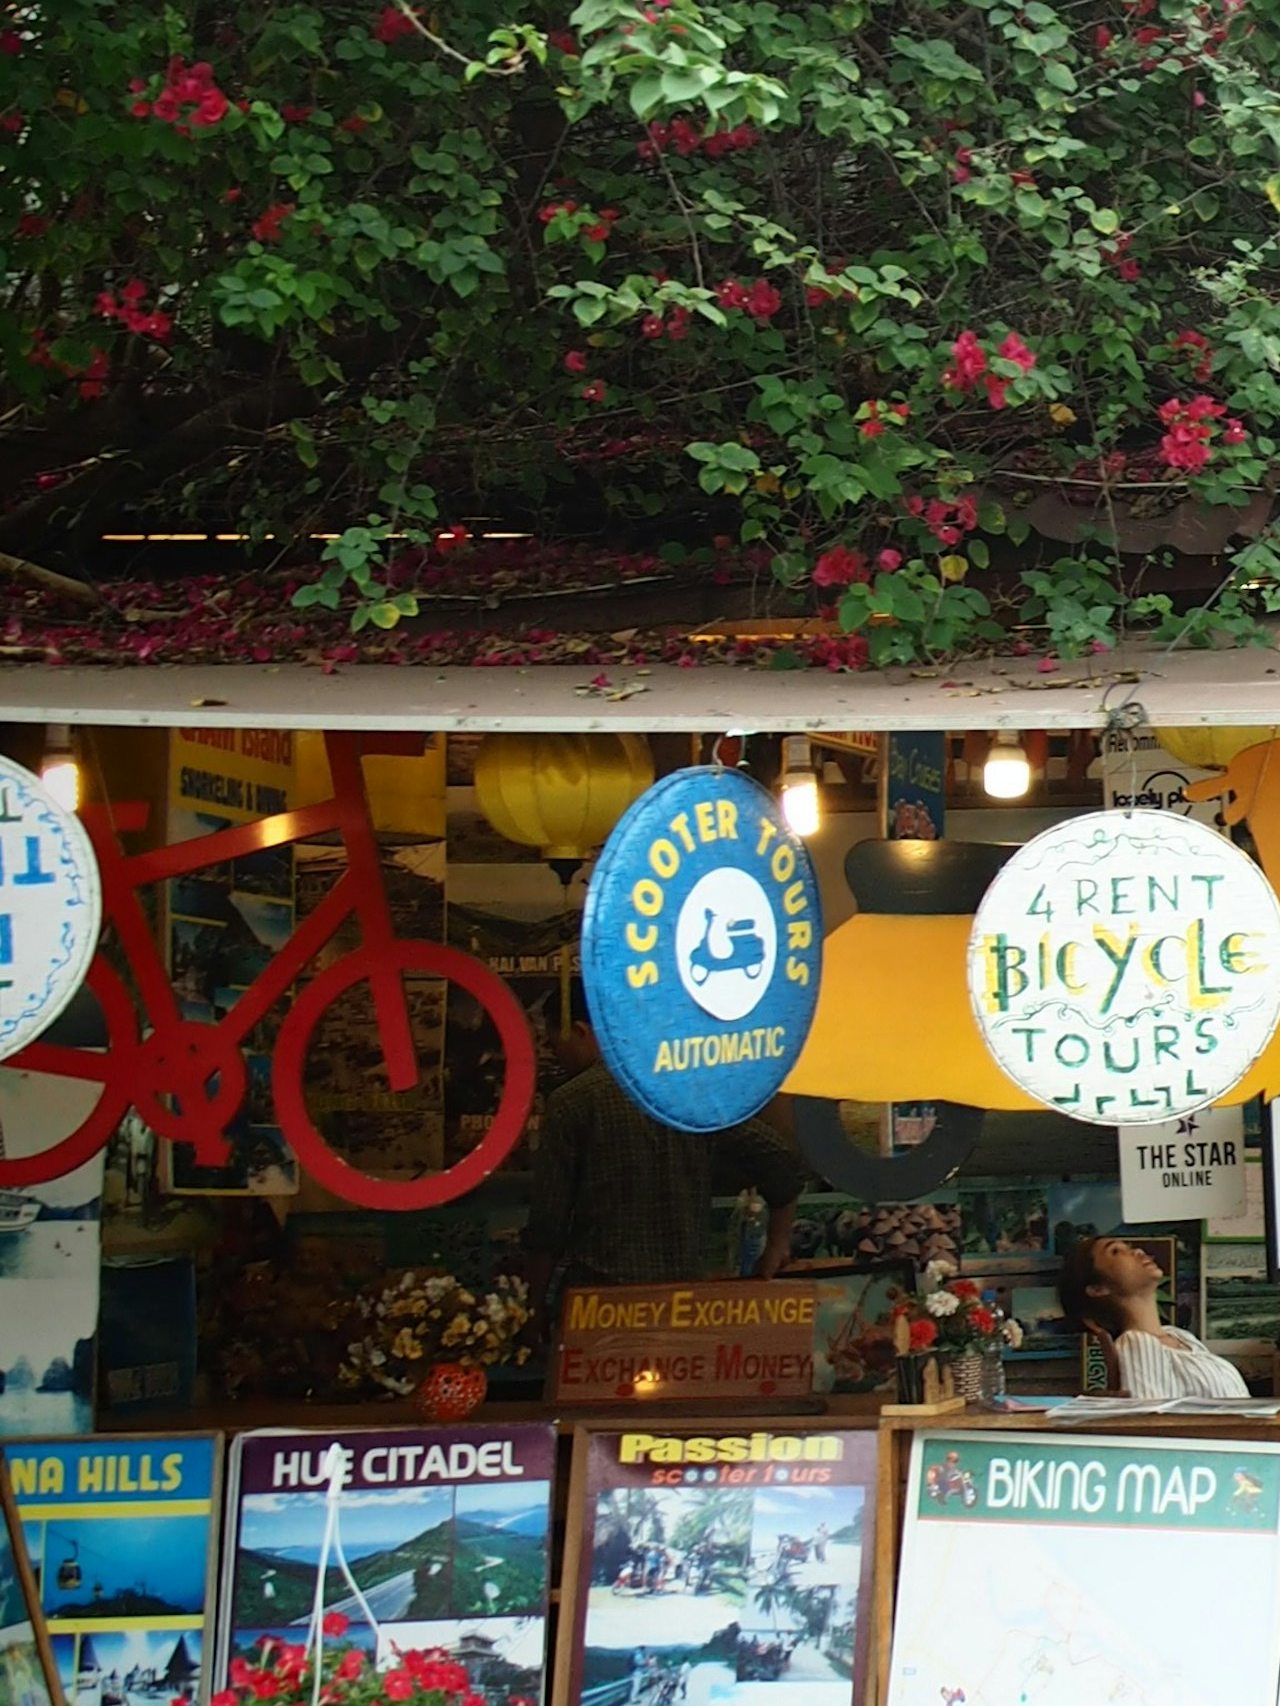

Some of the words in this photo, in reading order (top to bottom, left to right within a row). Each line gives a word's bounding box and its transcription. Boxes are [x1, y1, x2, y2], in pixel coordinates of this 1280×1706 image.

[626, 799, 738, 989] SCOOTER
[755, 817, 812, 986] TOURS
[1025, 883, 1055, 923] 4
[1074, 874, 1225, 917] RENT
[982, 919, 1269, 1015] BICYCLE
[654, 1026, 785, 1073] AUTOMATIC
[1011, 1017, 1219, 1074] TOURS
[1136, 1144, 1177, 1170] THE
[1184, 1141, 1237, 1167] STAR
[1162, 1170, 1213, 1188] ONLINE
[570, 1294, 666, 1330] MONEY
[669, 1291, 815, 1328] EXCHANGE
[561, 1348, 705, 1385] EXCHANGE
[715, 1343, 814, 1382] MONEY
[272, 1449, 354, 1487] HUE
[361, 1441, 524, 1483] CITADEL
[619, 1432, 844, 1464] Passion
[9, 1457, 65, 1495] NA
[78, 1453, 184, 1493] HILLS
[652, 1465, 758, 1484] scooter
[764, 1465, 832, 1483] tours
[986, 1458, 1107, 1513] BIKING
[1116, 1462, 1218, 1515] MAP
